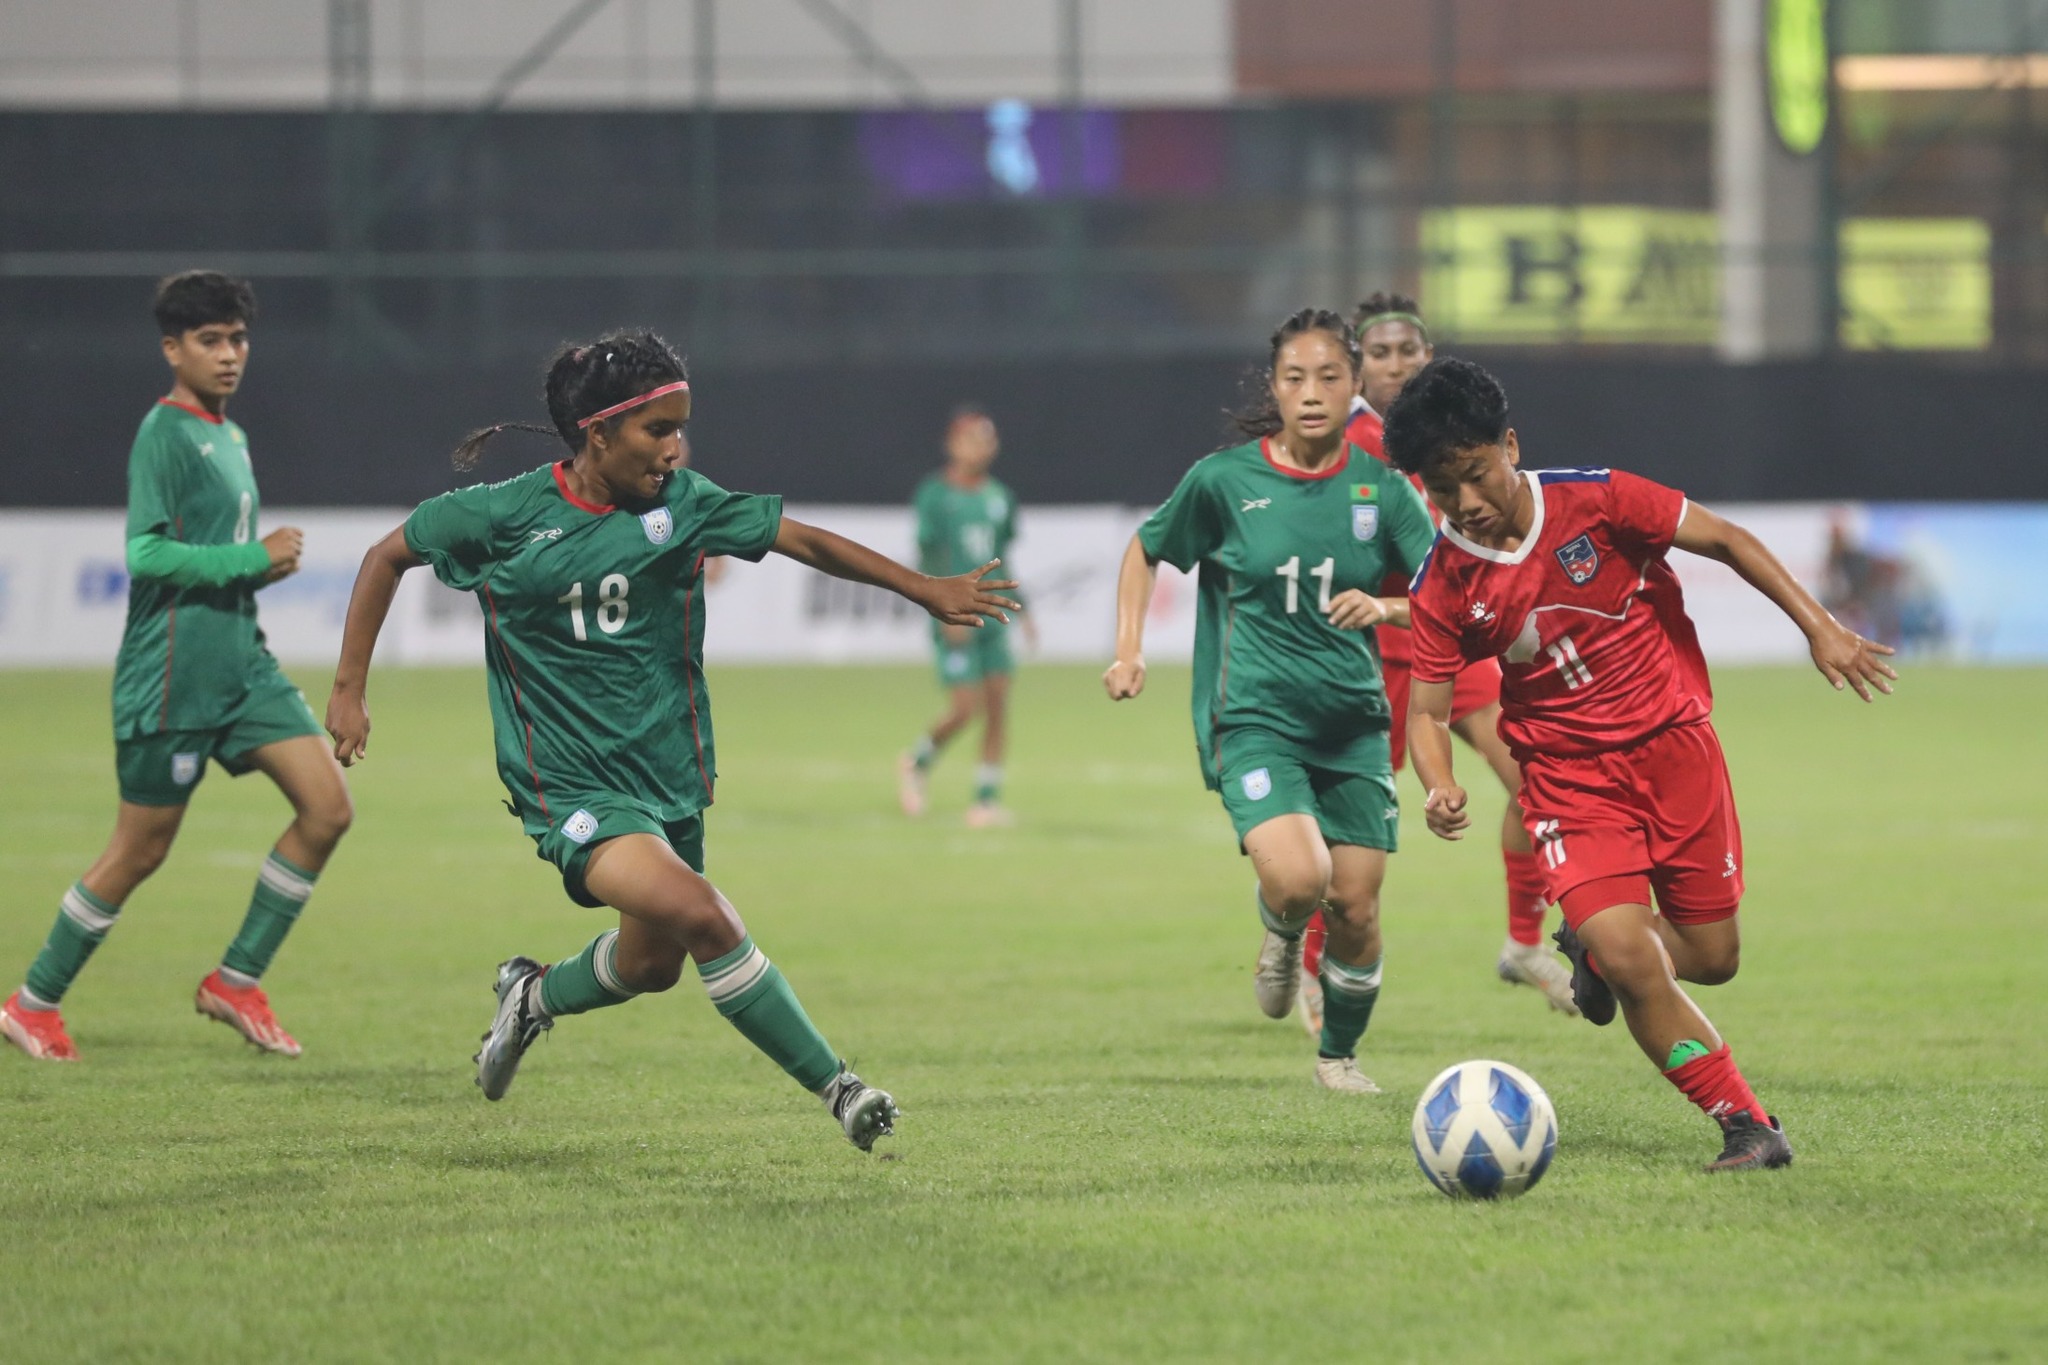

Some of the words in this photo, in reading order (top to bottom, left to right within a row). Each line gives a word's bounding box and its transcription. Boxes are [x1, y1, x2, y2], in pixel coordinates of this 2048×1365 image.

[558, 573, 629, 641] 18
[1276, 556, 1335, 613] 11
[1546, 635, 1593, 690] 11
[1535, 818, 1567, 870] 11
